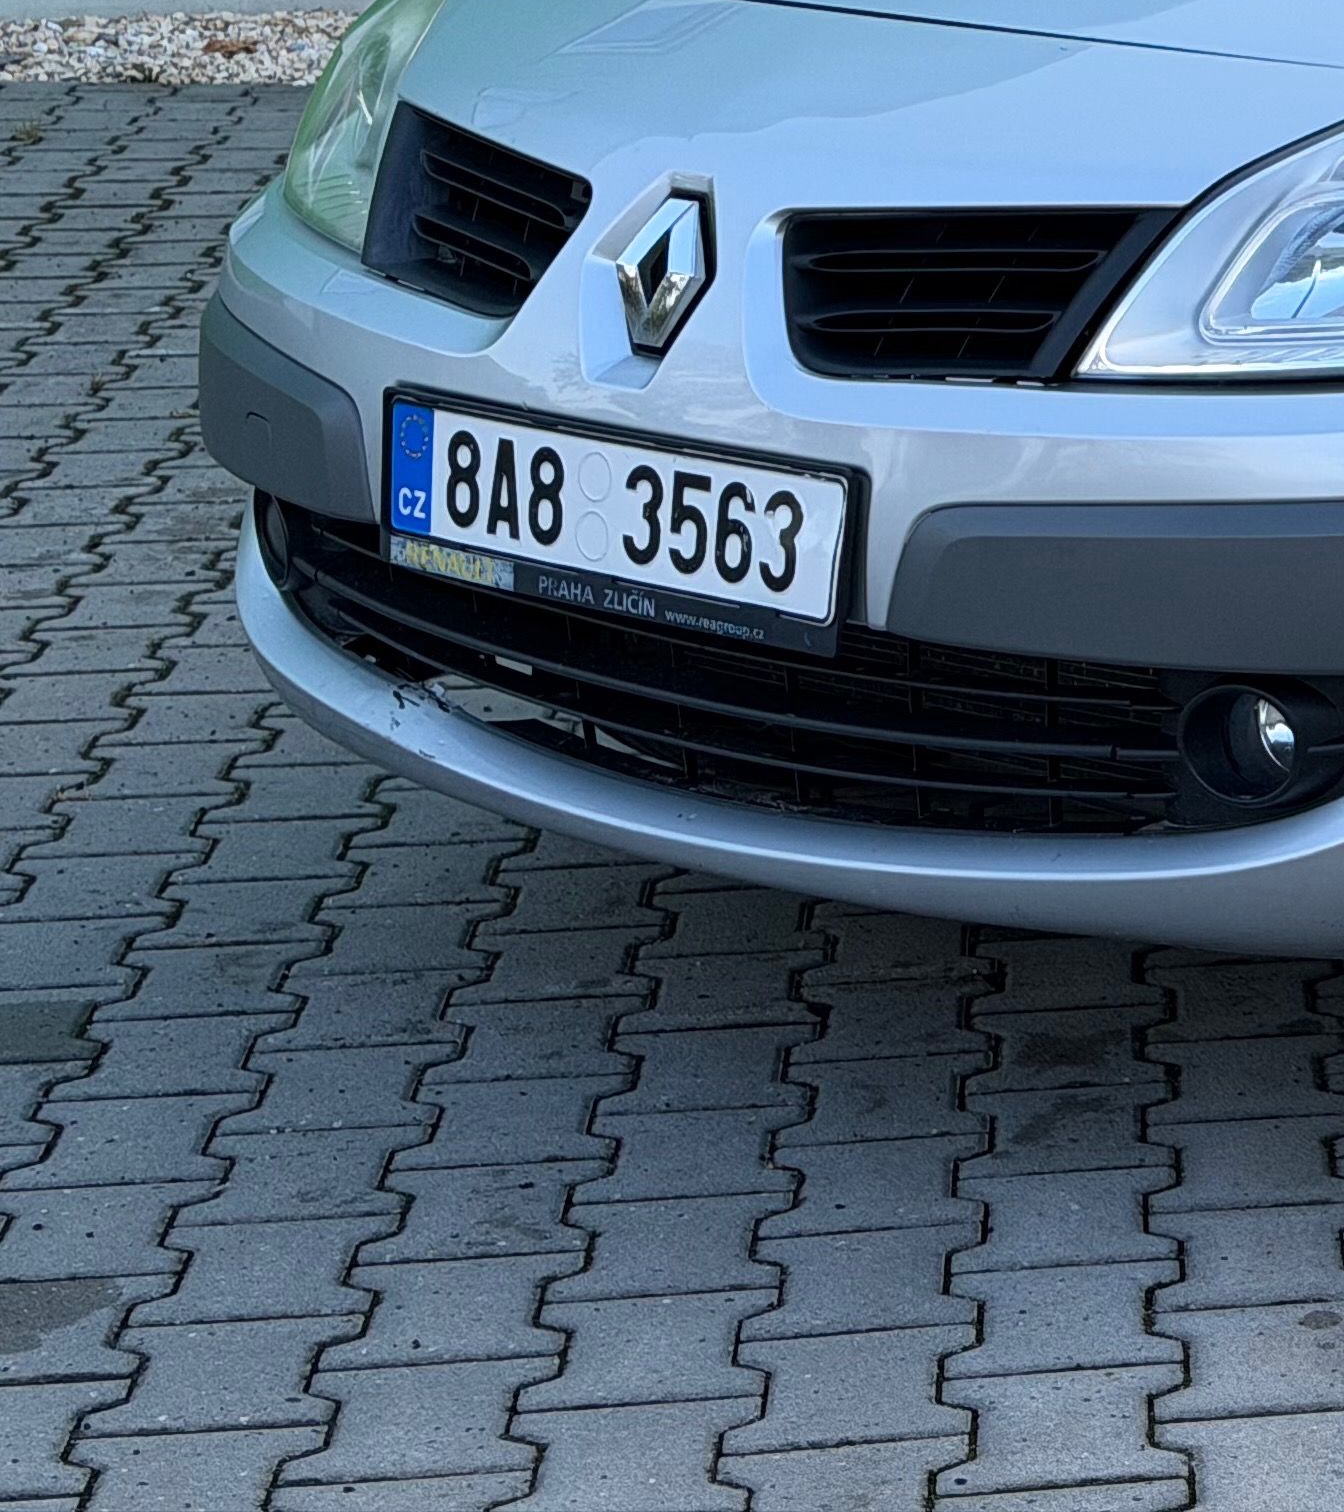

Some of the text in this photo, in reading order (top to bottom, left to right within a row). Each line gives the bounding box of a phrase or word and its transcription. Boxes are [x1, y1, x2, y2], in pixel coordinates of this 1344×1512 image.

[398, 487, 427, 519] CZ
[446, 430, 804, 593] 8A8 3563
[538, 575, 765, 640] PRAHA ZLIČÍN www.reagroup.cz
